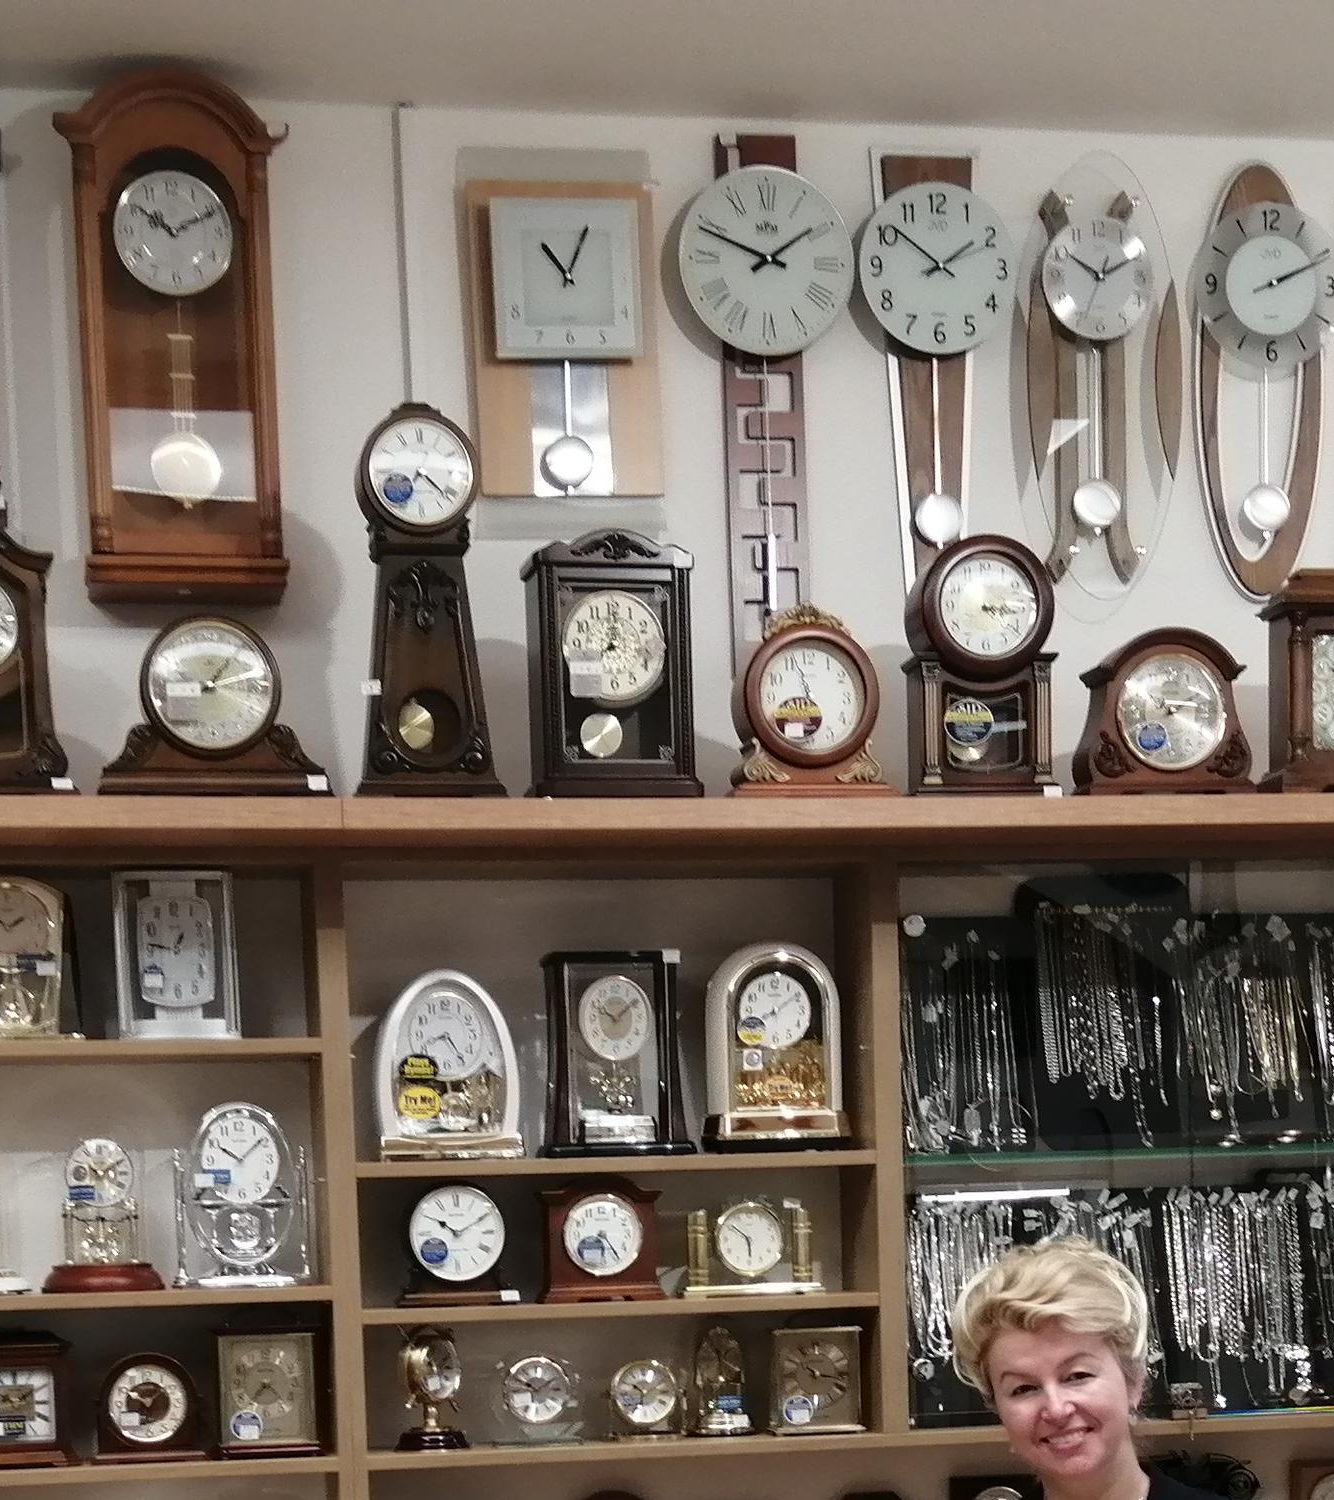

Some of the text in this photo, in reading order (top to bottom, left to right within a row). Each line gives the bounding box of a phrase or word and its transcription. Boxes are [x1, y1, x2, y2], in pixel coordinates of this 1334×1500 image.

[901, 202, 914, 223] 11
[928, 193, 946, 214] 12
[963, 202, 969, 223] 1
[1262, 209, 1280, 231] 12
[877, 224, 898, 246] 10
[985, 226, 996, 248] 2
[870, 255, 883, 277] 9
[996, 258, 1008, 280] 3
[1205, 274, 1217, 294] 9
[881, 289, 892, 311] 8
[985, 292, 998, 313] 4
[906, 313, 917, 335] 7
[934, 322, 946, 344] 6
[964, 315, 975, 336] 5
[1267, 340, 1278, 362] 6
